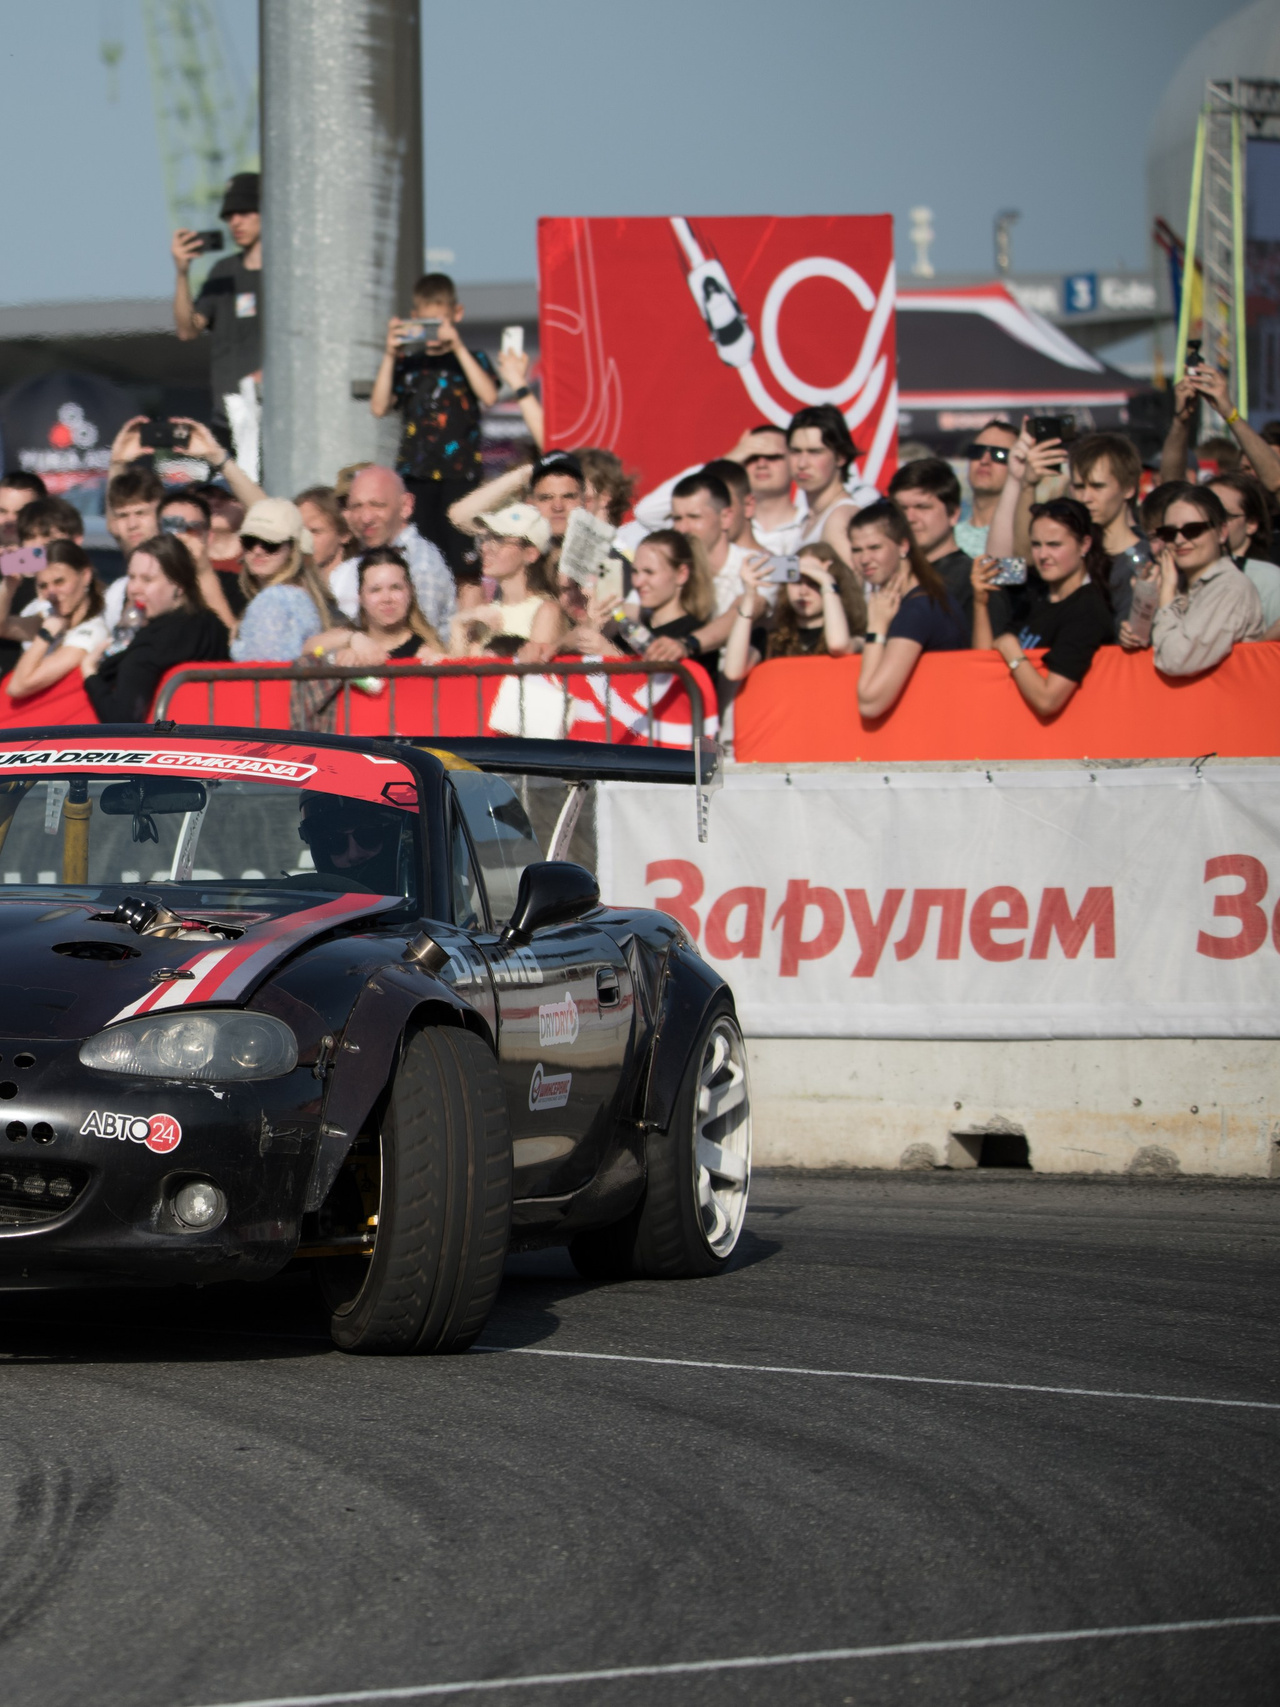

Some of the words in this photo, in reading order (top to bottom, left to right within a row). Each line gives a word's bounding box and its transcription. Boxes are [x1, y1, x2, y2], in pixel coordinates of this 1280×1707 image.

[54, 752, 152, 764] DRIVE
[156, 754, 298, 776] GYMKHANA
[1195, 854, 1280, 961] З
